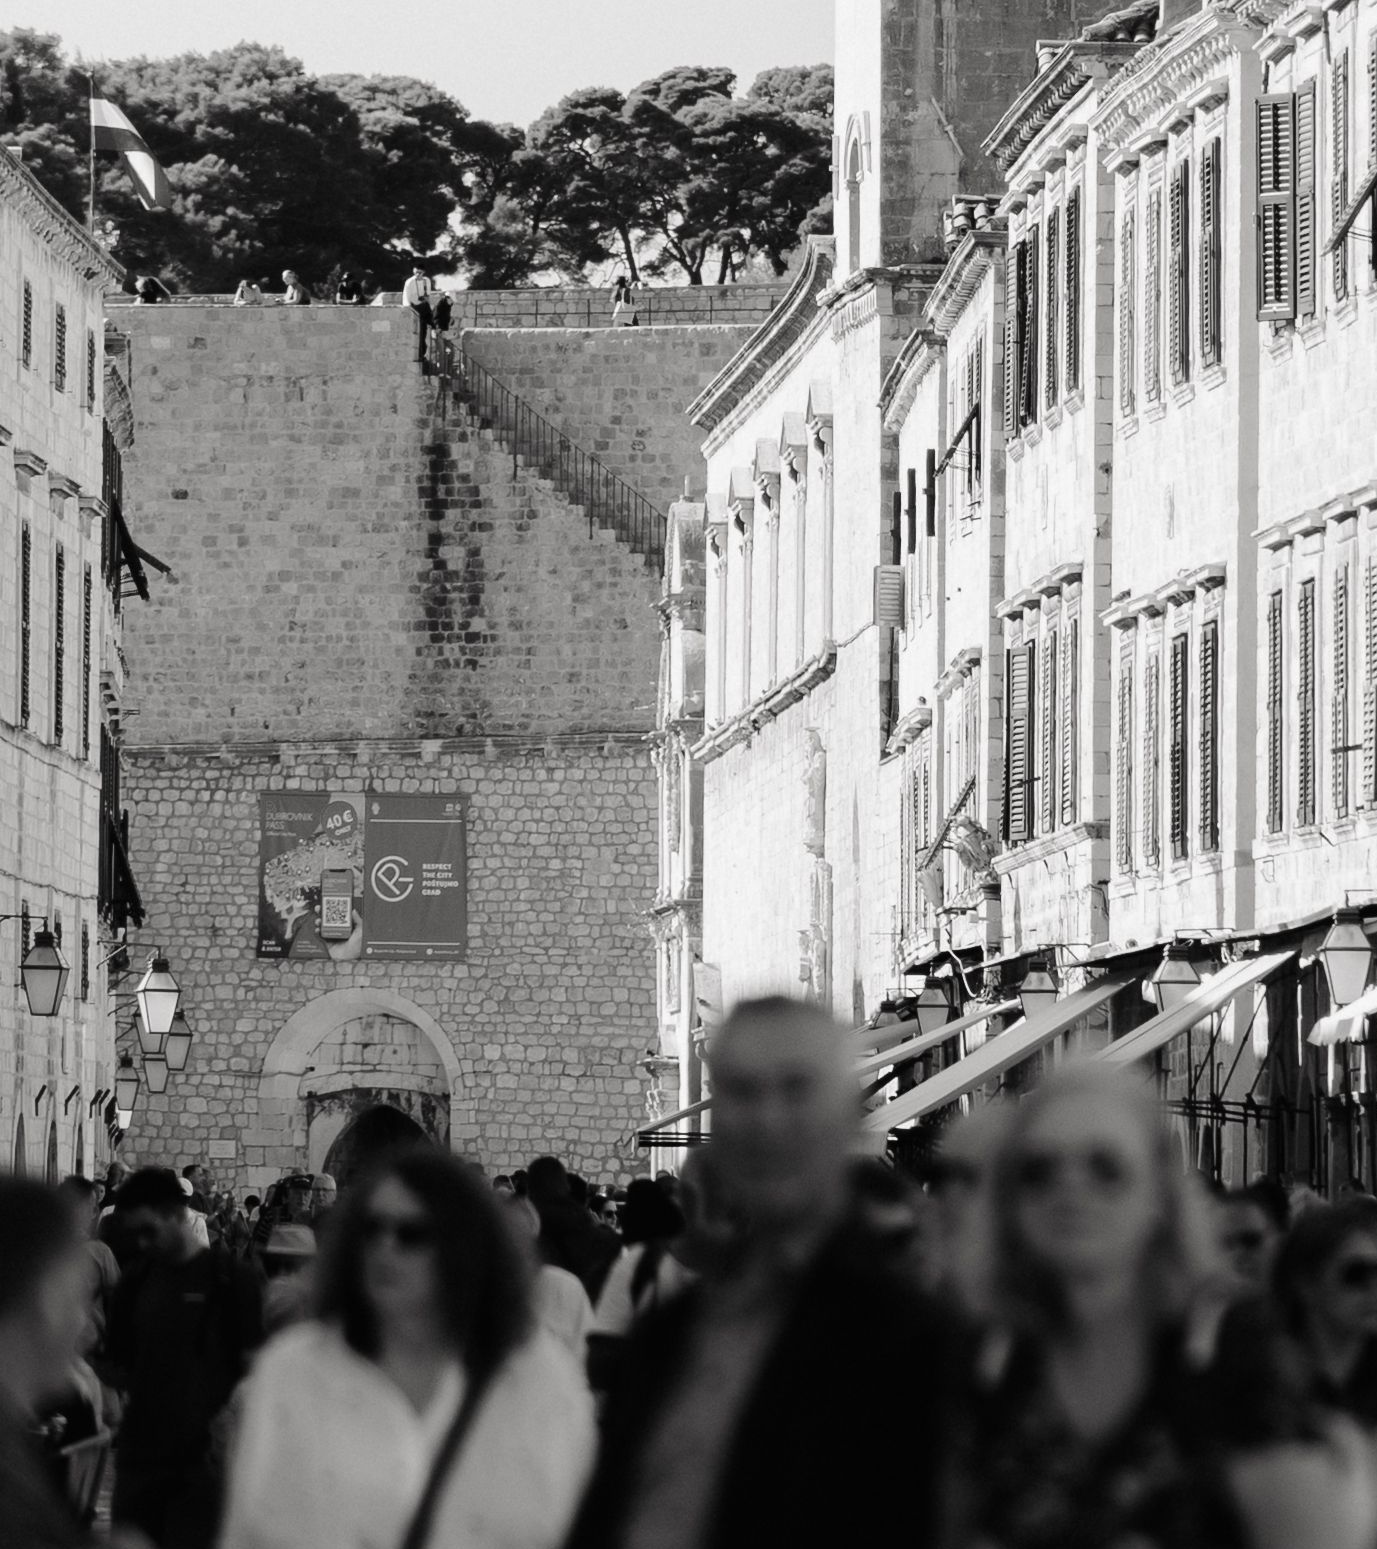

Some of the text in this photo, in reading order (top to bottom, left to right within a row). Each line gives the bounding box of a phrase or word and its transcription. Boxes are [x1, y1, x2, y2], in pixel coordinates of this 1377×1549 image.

[326, 809, 354, 829] 40 €
[436, 871, 453, 879] CITY
